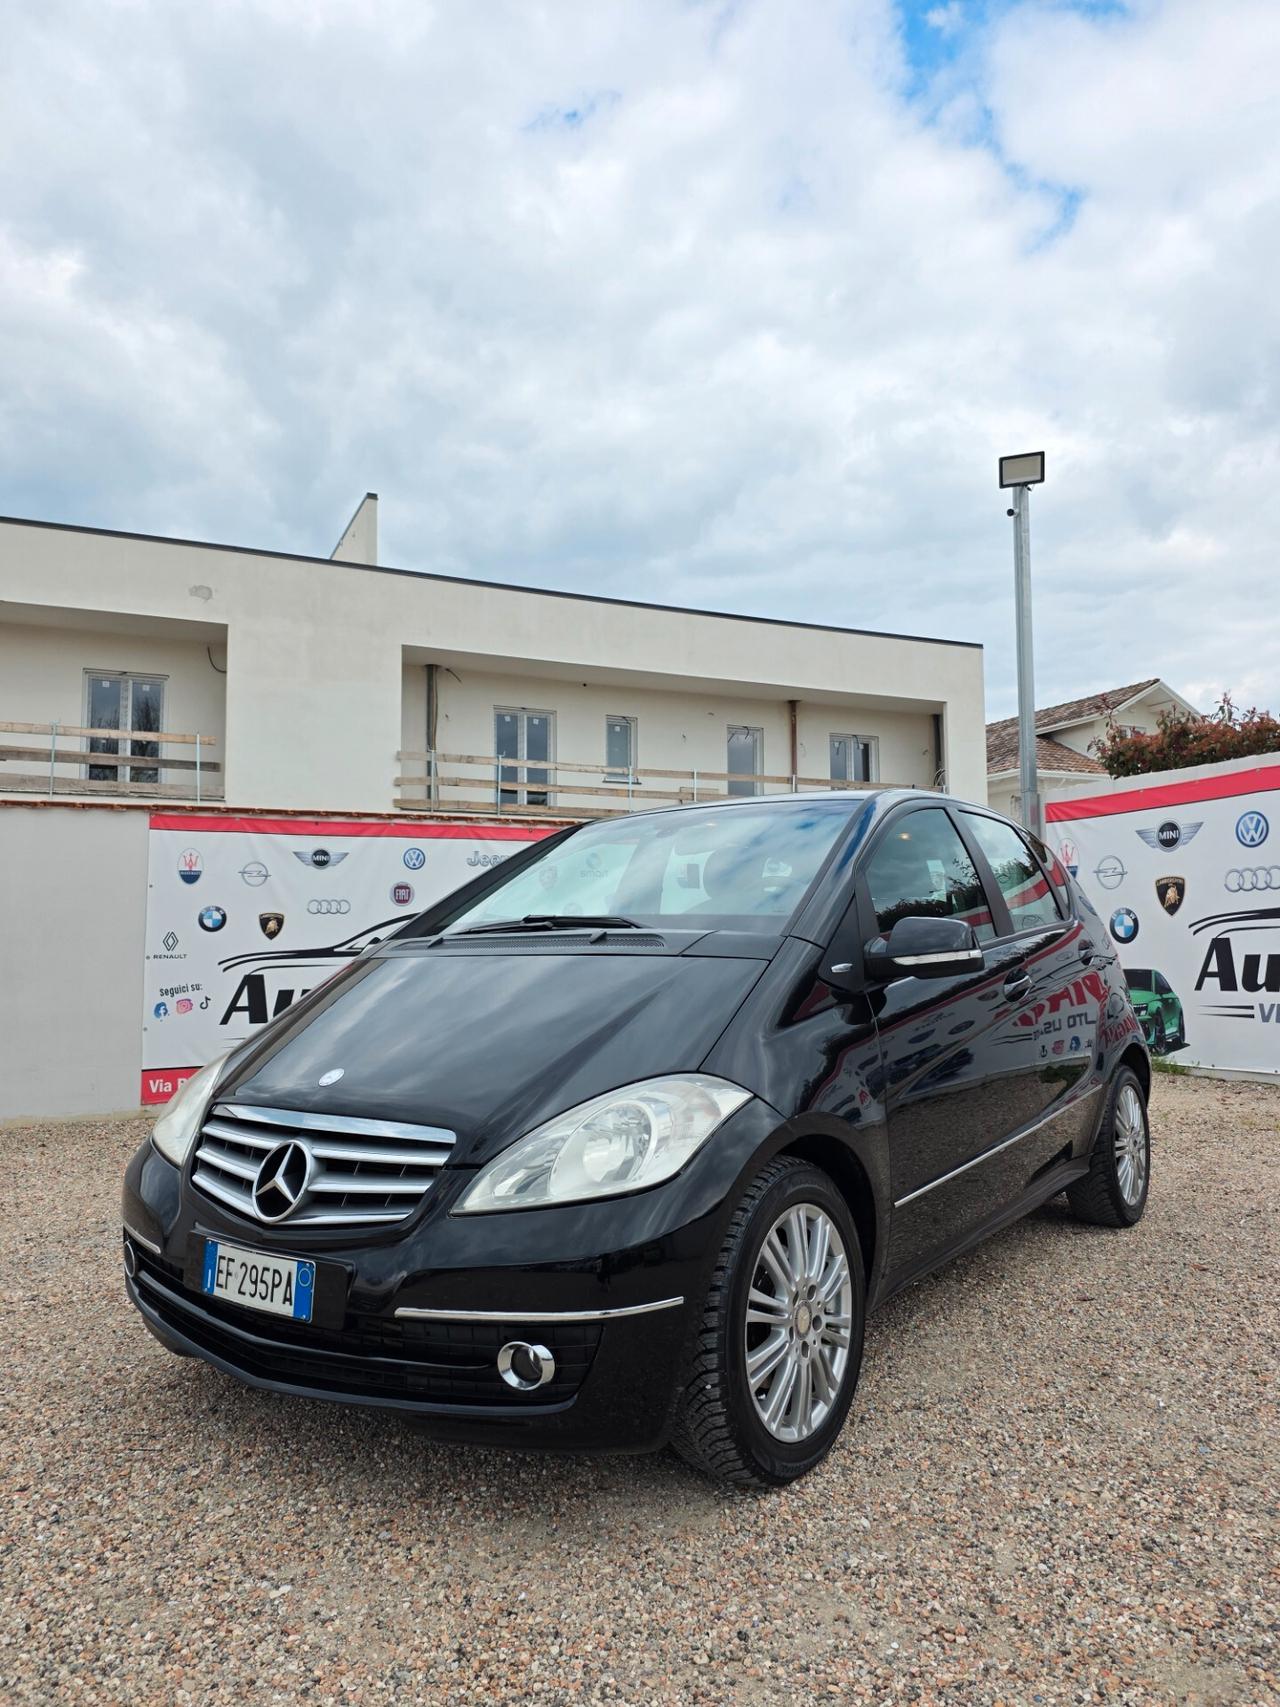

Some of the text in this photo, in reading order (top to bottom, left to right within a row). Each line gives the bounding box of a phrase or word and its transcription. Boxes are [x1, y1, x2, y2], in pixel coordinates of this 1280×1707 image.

[1158, 829, 1179, 841] MINI
[312, 854, 330, 862] MINI
[466, 850, 509, 867] Jee
[395, 889, 410, 899] FIAT
[148, 1078, 172, 1094] Via
